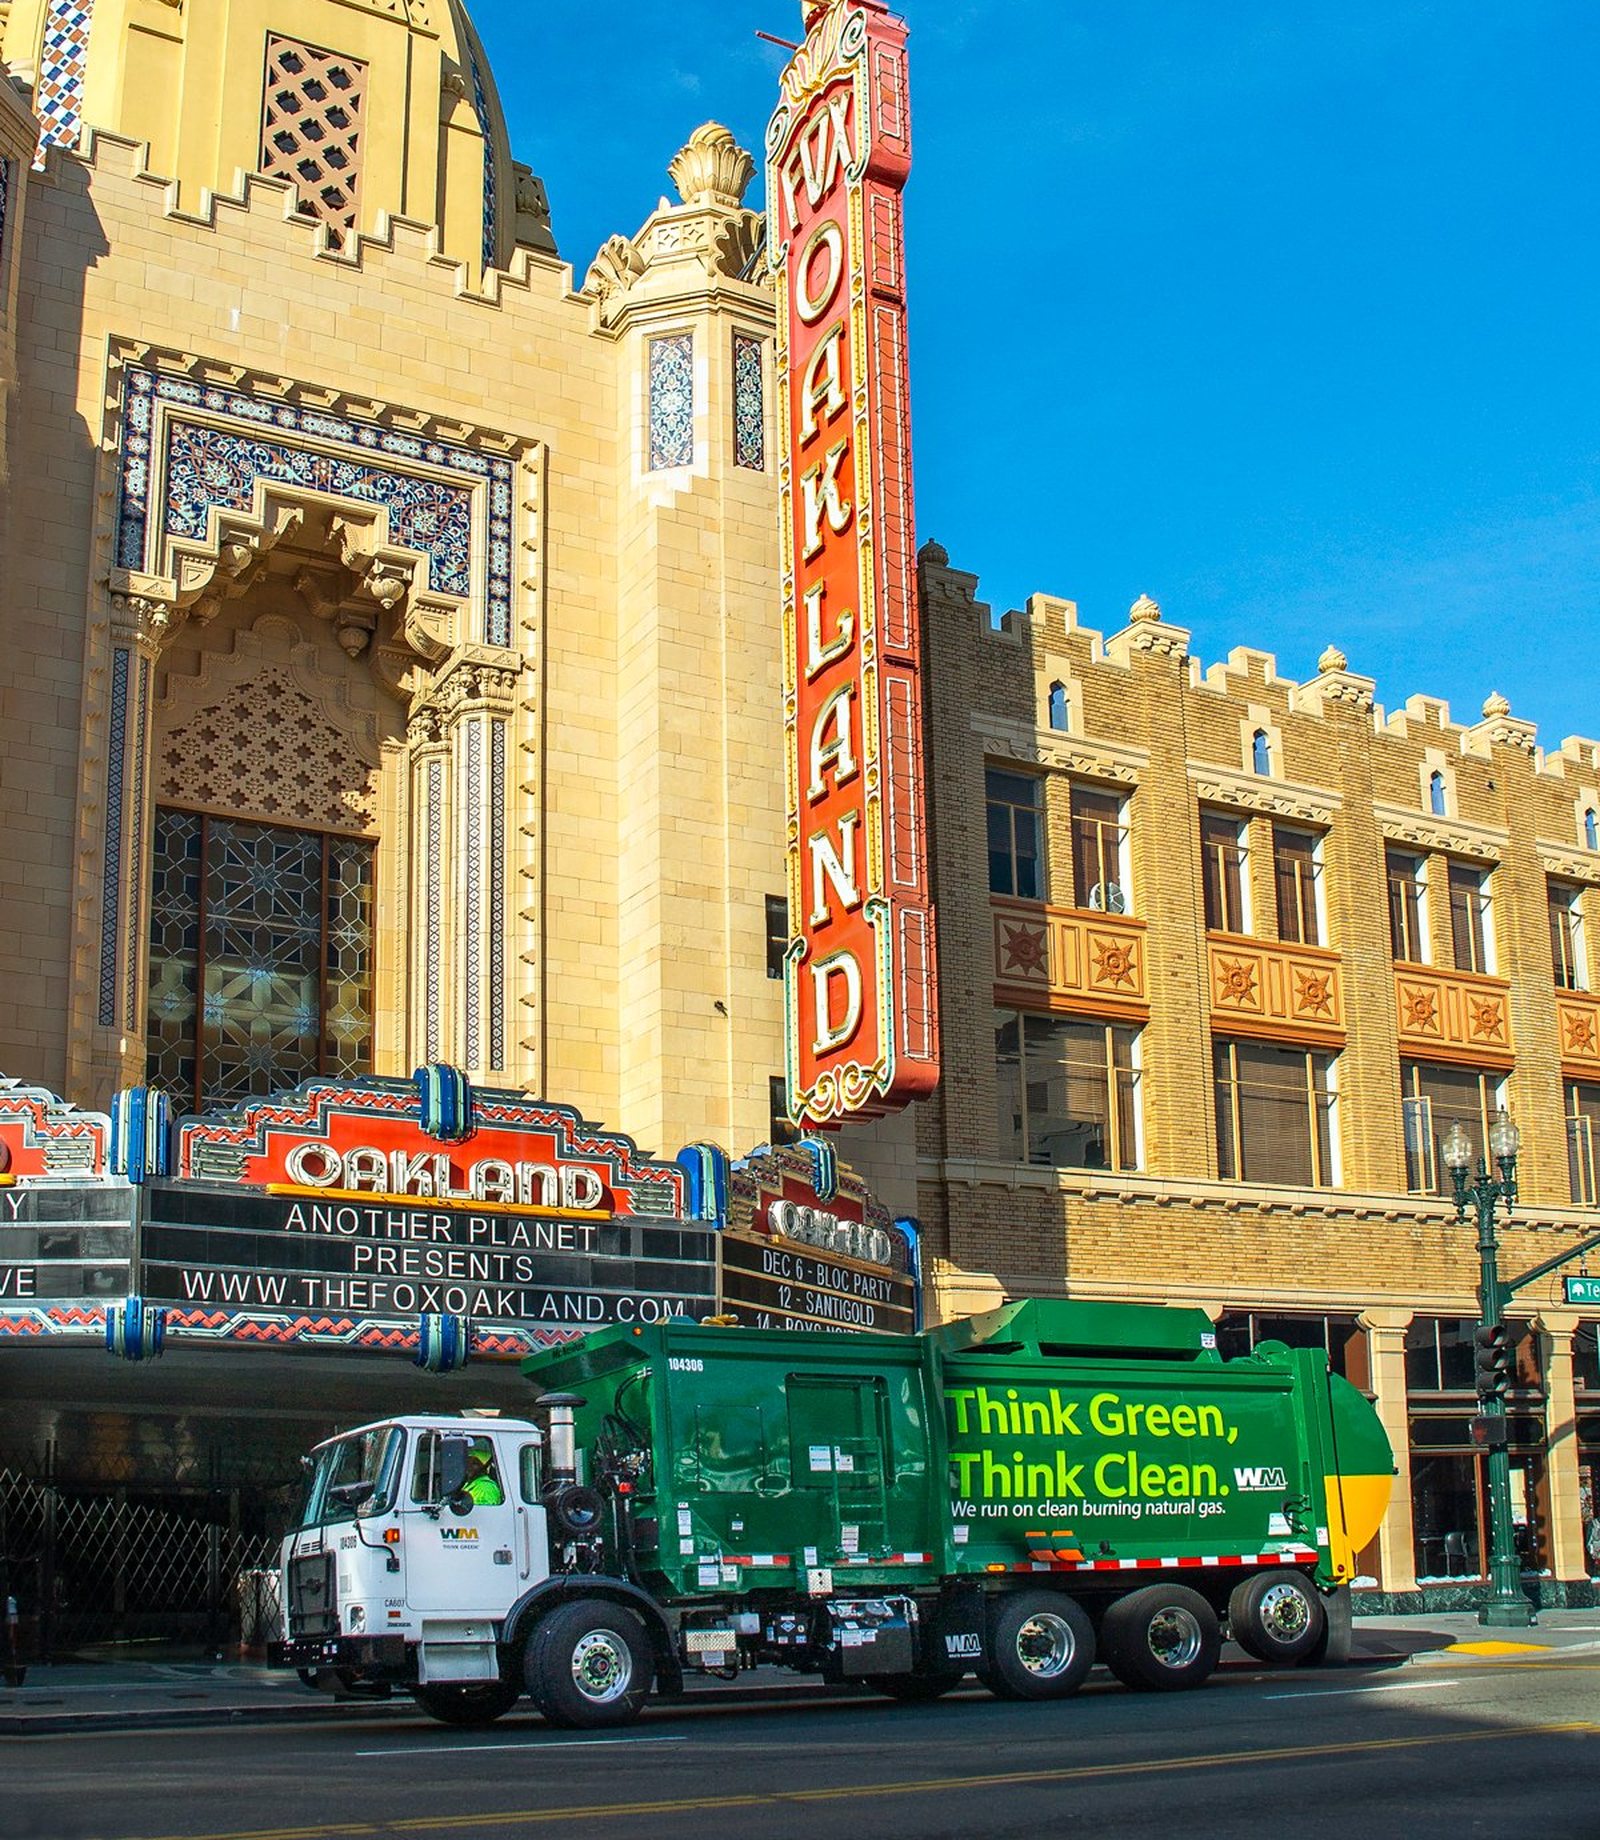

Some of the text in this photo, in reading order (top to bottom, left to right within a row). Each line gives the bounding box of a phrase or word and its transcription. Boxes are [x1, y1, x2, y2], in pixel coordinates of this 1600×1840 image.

[780, 88, 856, 231] FOX
[794, 218, 862, 1057] OAKLAND
[284, 1142, 602, 1210] OAKLAND
[285, 1204, 596, 1252] ANOTHER PLANET
[768, 1200, 892, 1265] OAKLAND
[355, 1245, 533, 1282] PRESENTS
[763, 1250, 791, 1277] DEC
[795, 1258, 804, 1280] 6
[816, 1264, 849, 1292] BLOC
[853, 1273, 893, 1302] PARTY
[183, 1271, 684, 1324] WWW.THEFOXOAKLAND.COM
[778, 1285, 792, 1309] 12
[805, 1291, 875, 1327] SANTIGOLD
[1586, 1282, 1600, 1298] Te
[756, 1312, 770, 1330] 14
[668, 1358, 704, 1371] 104306
[943, 1387, 1239, 1445] Think Green,
[949, 1450, 1230, 1498] Think Clean.
[1233, 1467, 1288, 1487] WM
[951, 1498, 1227, 1520] We run on clean burning natural gas.
[440, 1528, 480, 1540] WM
[945, 1633, 982, 1653] WM
